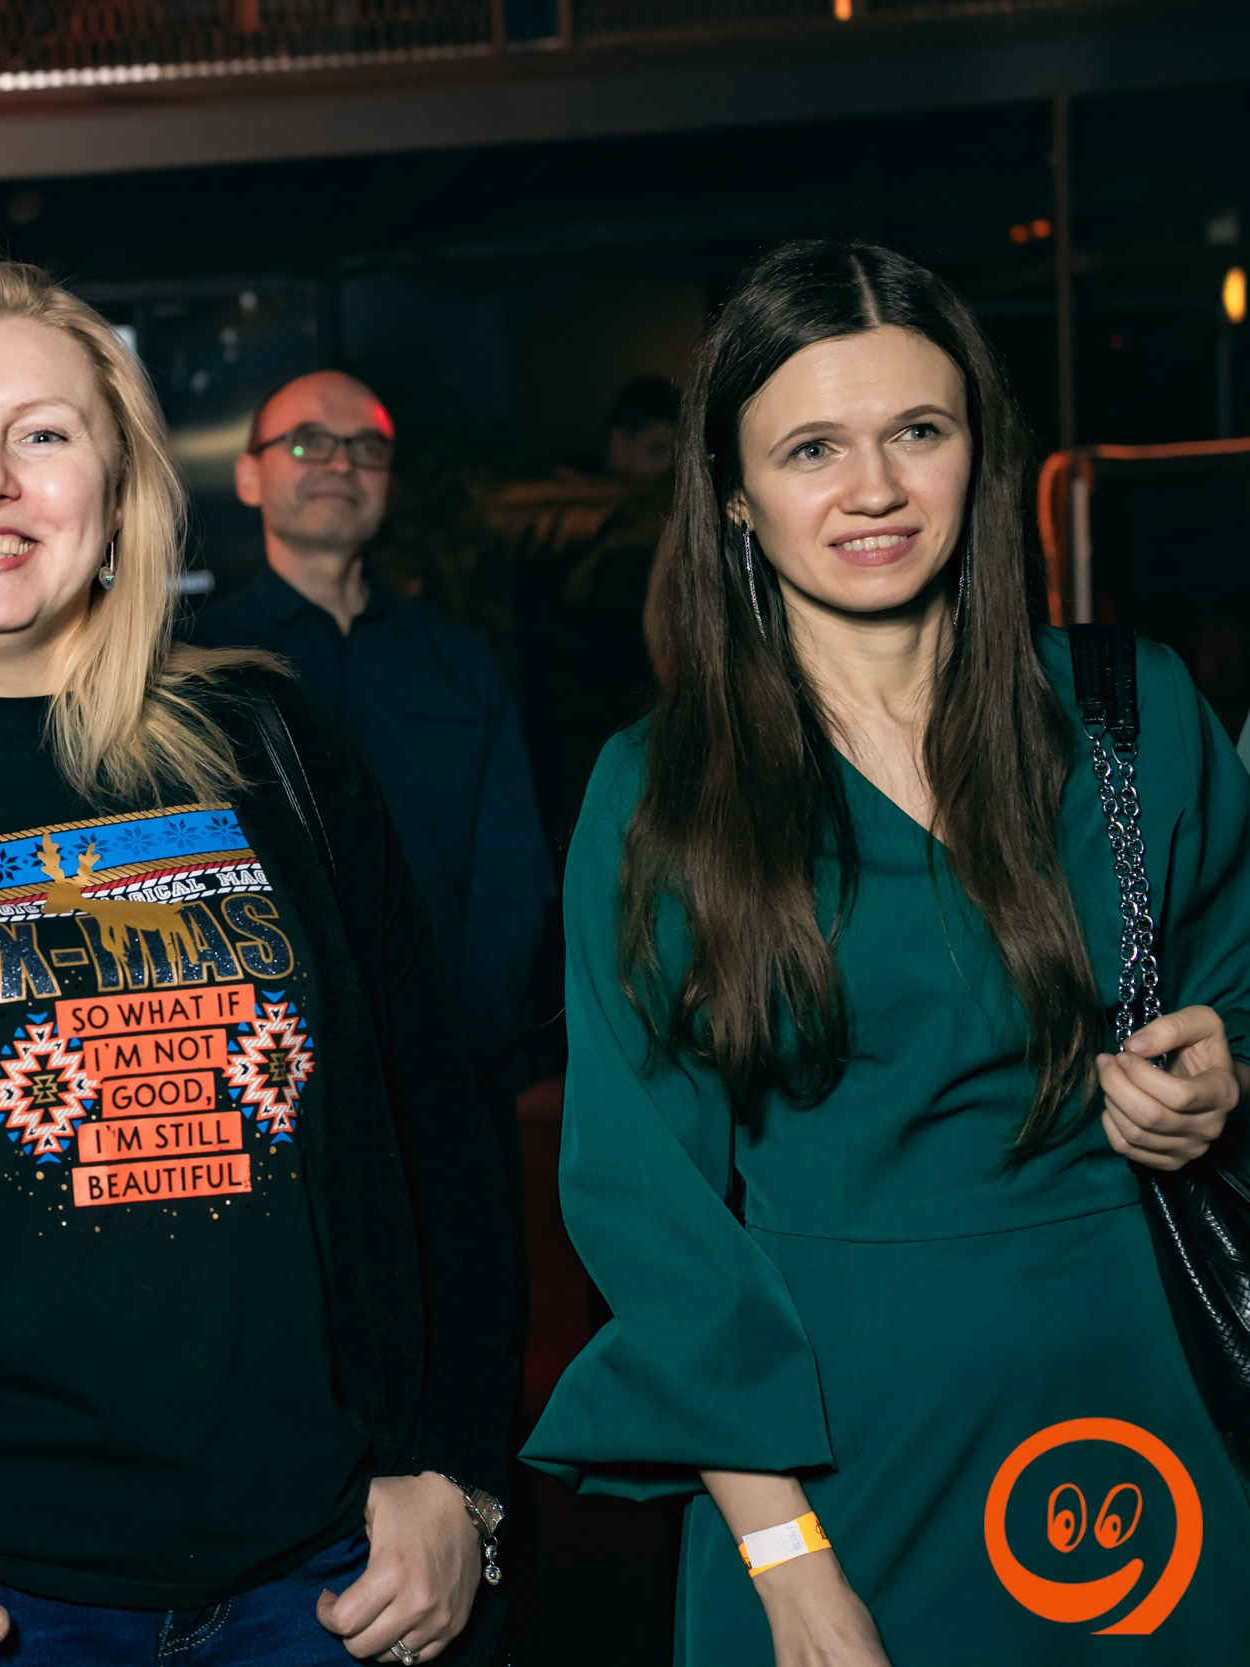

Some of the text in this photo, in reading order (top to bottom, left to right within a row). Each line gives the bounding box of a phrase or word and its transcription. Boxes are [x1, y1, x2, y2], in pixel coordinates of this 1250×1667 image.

[72, 991, 239, 1031] SO WHAT IF
[94, 1035, 213, 1072] I'M NOT
[112, 1078, 212, 1110] GOOD,
[96, 1119, 230, 1153] I'M STILL
[88, 1162, 242, 1200] BEAUTIFUL
